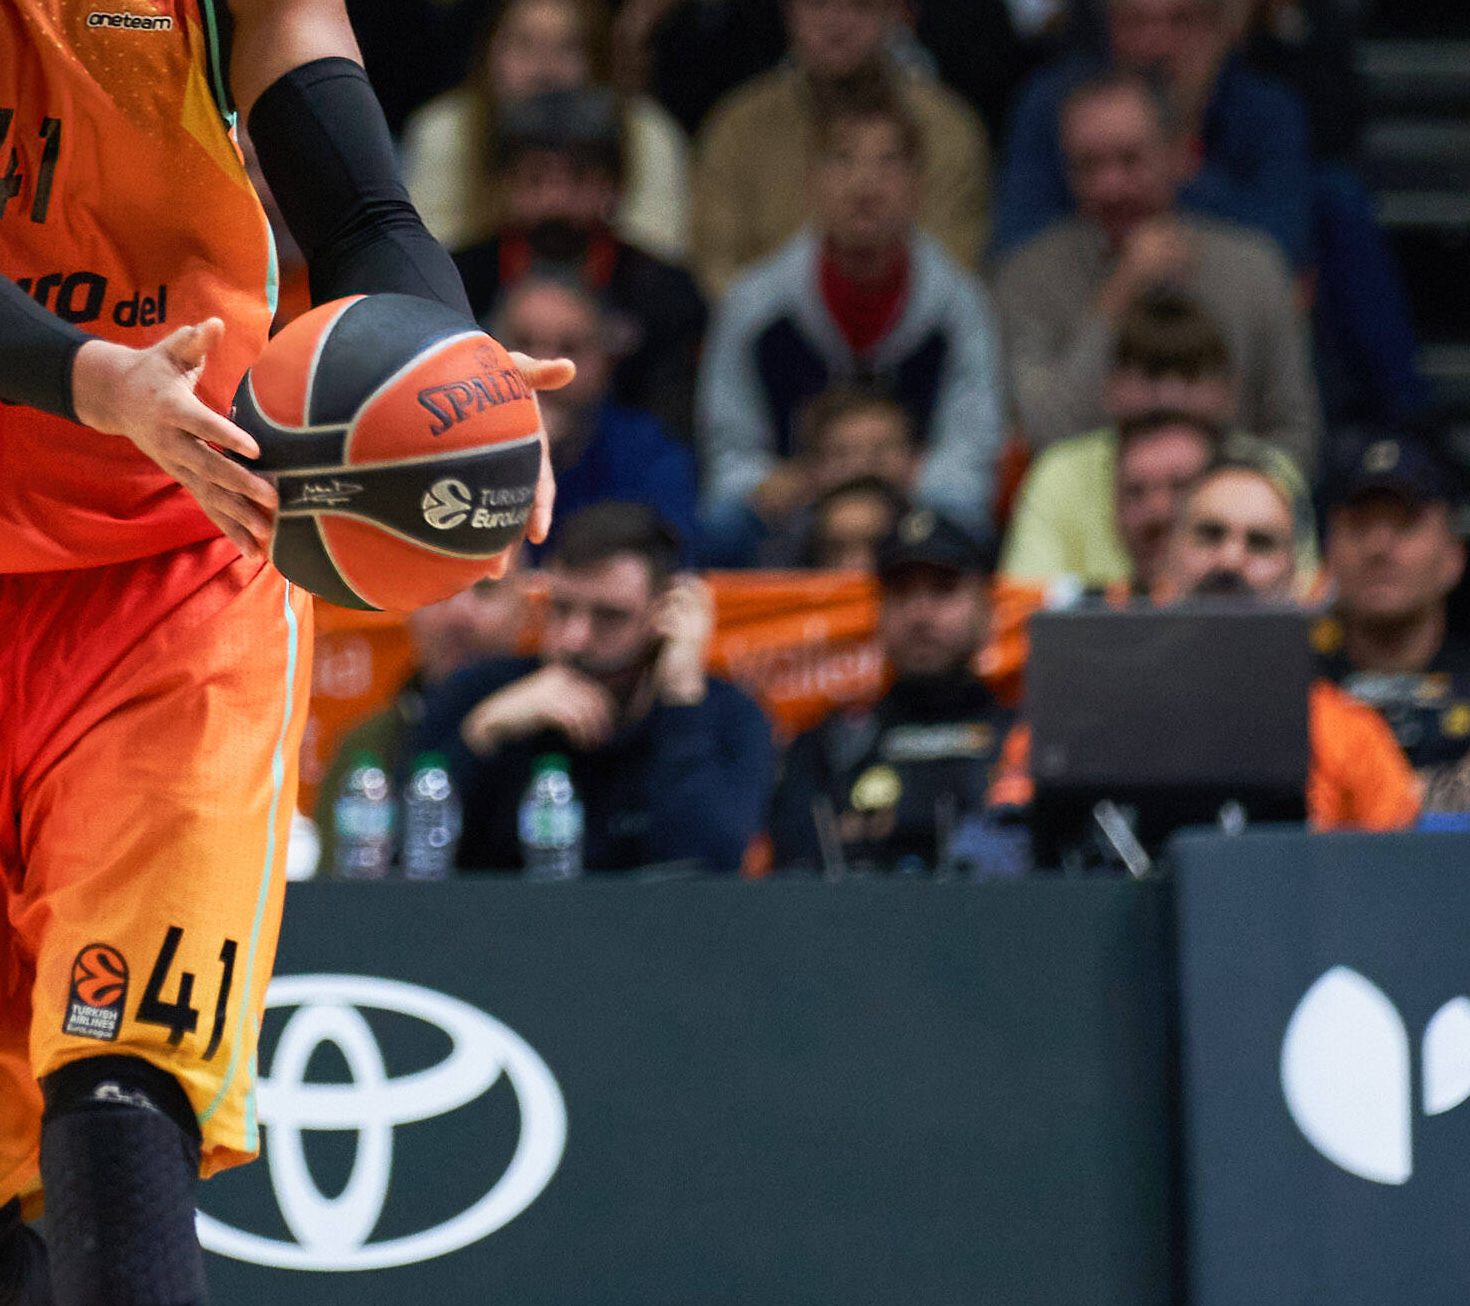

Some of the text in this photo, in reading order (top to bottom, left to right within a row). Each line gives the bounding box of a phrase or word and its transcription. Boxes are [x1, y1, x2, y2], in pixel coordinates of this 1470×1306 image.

[88, 13, 172, 30] oneteam
[112, 285, 167, 328] del
[135, 924, 239, 1062] 41
